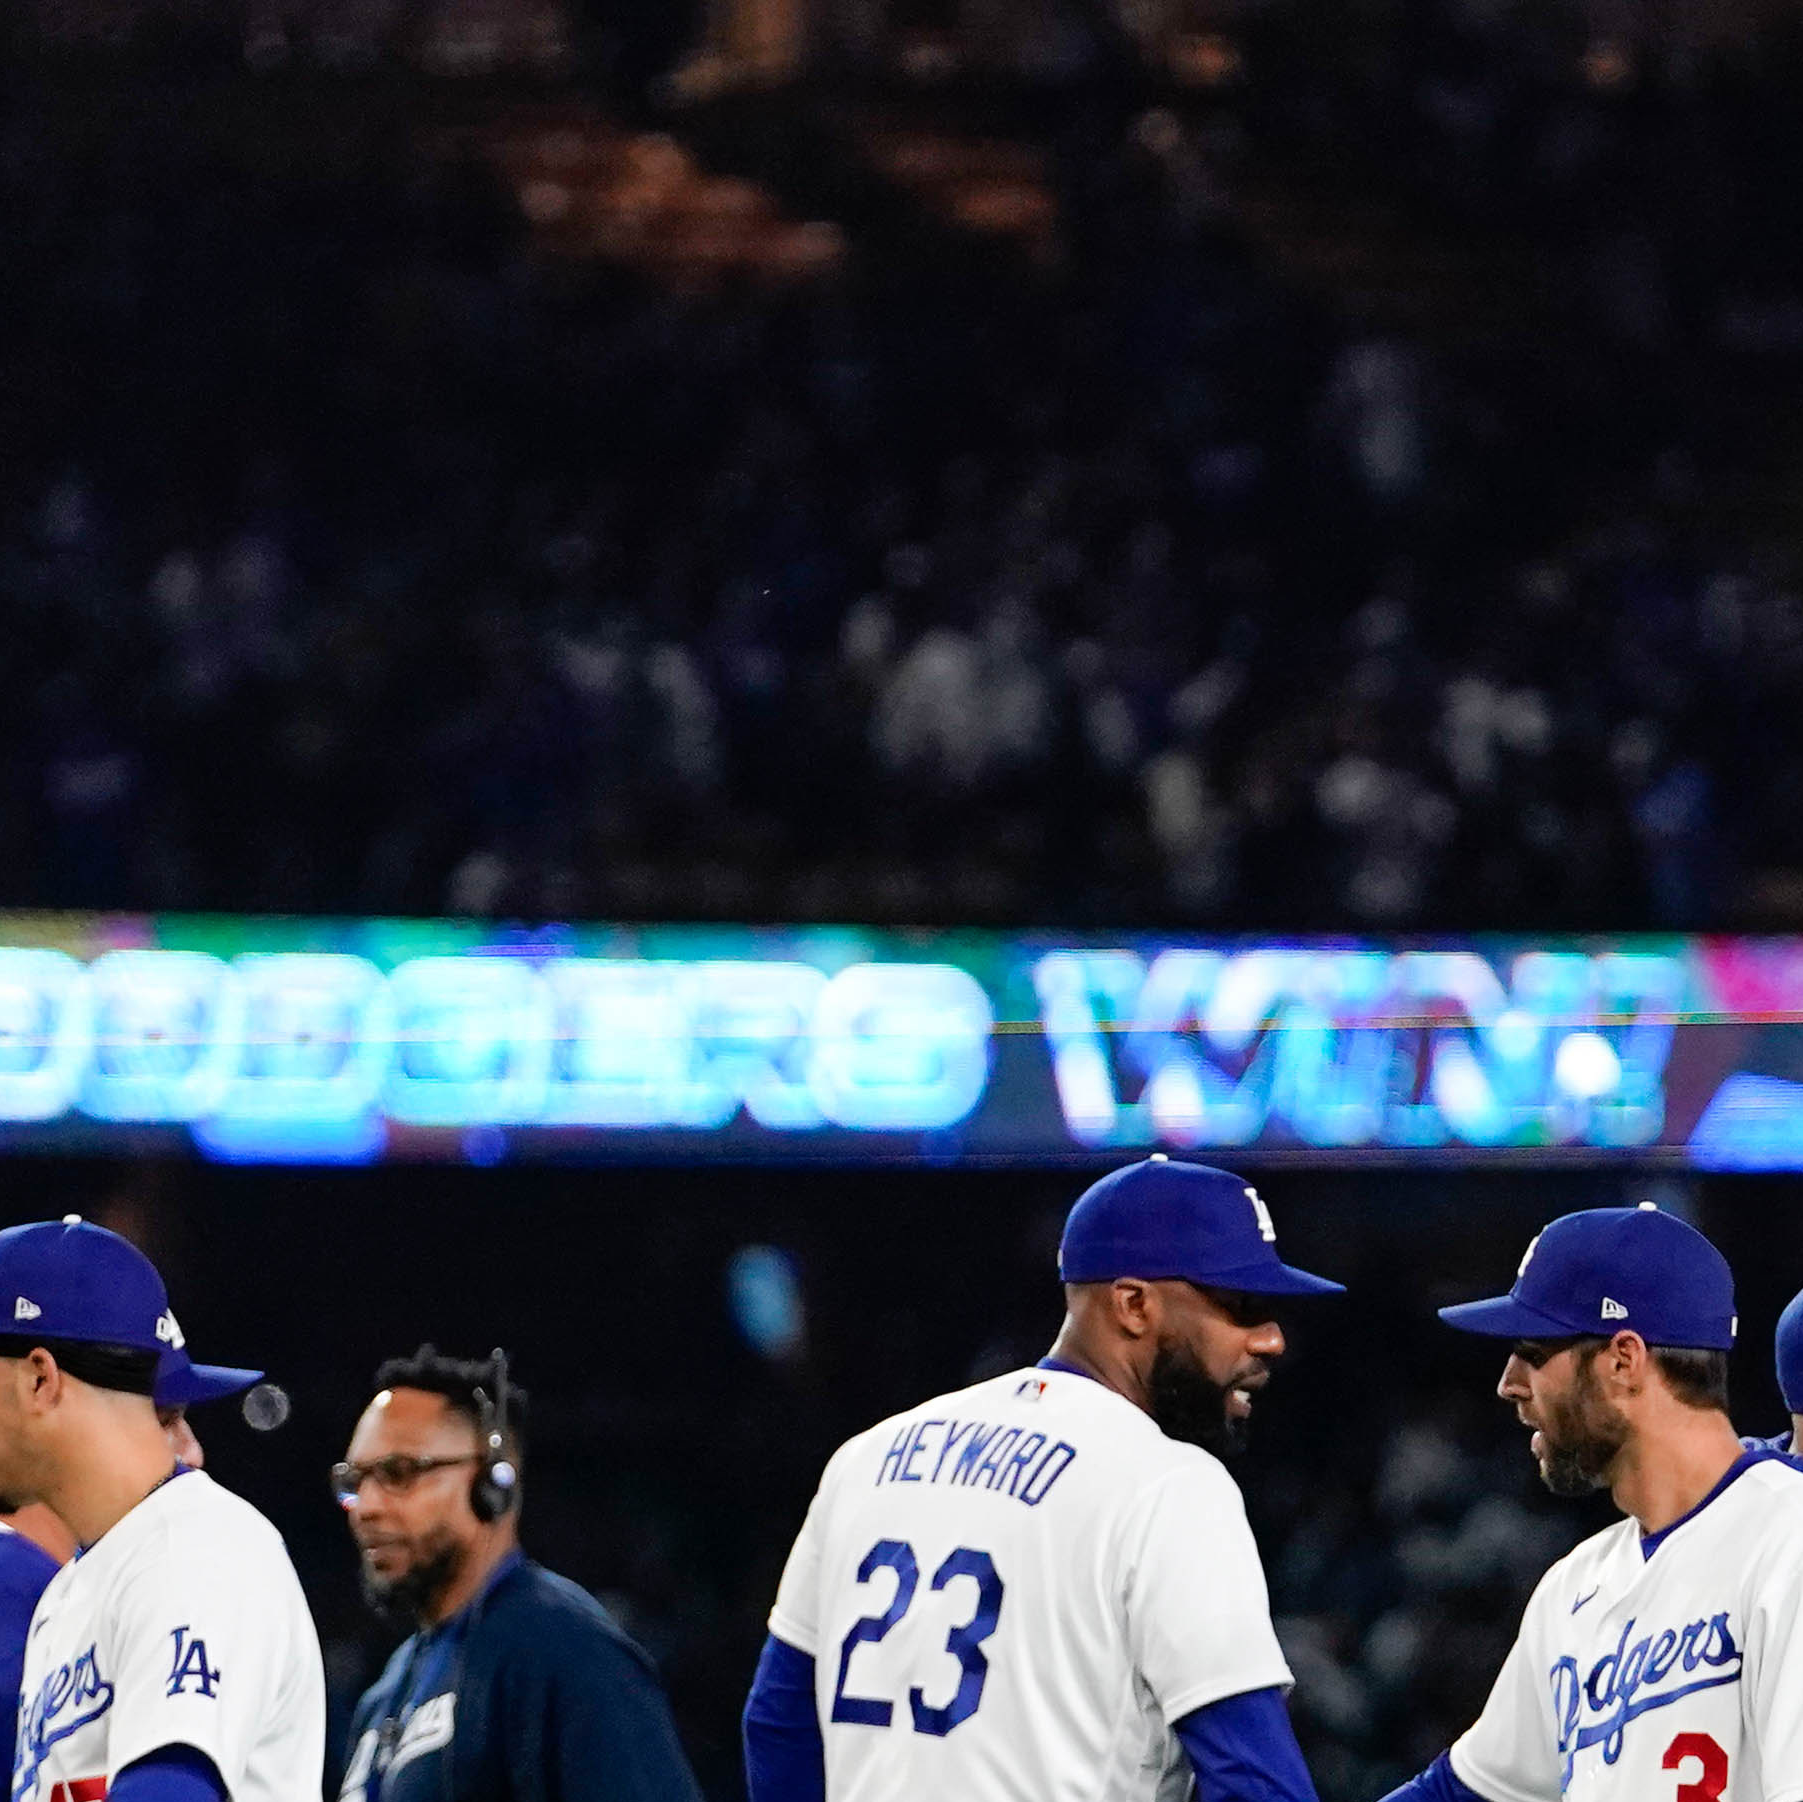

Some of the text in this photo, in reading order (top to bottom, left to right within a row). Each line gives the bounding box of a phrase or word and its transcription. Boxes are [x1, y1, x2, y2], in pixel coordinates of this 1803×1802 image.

[875, 1419, 1077, 1507] HEYWARD
[166, 1624, 221, 1699] LA
[831, 1538, 1004, 1737] 23
[1549, 1611, 1744, 1792] Ddgers
